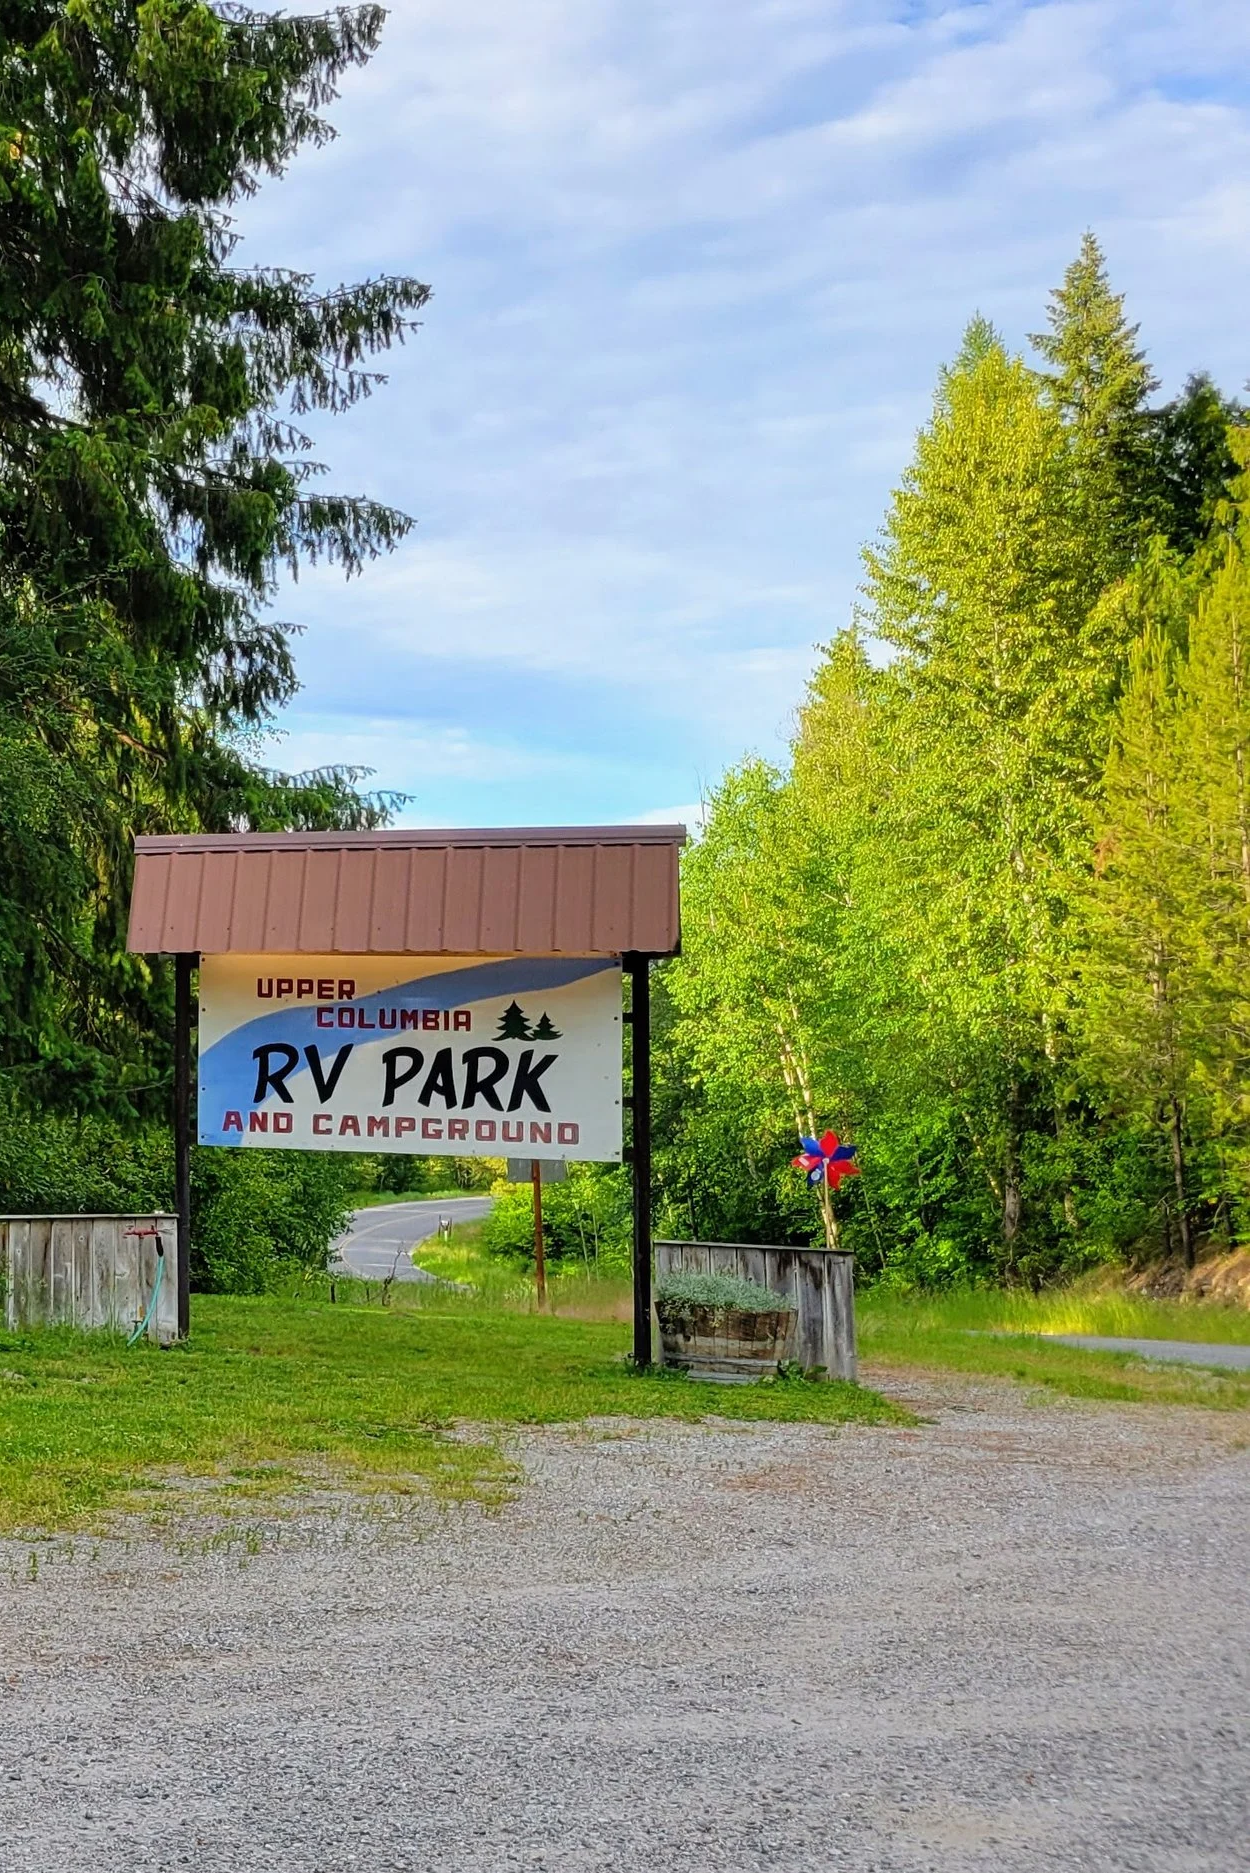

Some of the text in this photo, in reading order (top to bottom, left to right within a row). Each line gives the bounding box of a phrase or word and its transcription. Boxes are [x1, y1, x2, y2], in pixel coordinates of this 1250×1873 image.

[257, 977, 356, 1000] UPPER
[316, 1007, 472, 1032] COLUMBIA
[252, 1042, 559, 1113] RV PARK
[222, 1111, 580, 1145] AND CAMPGROUND
